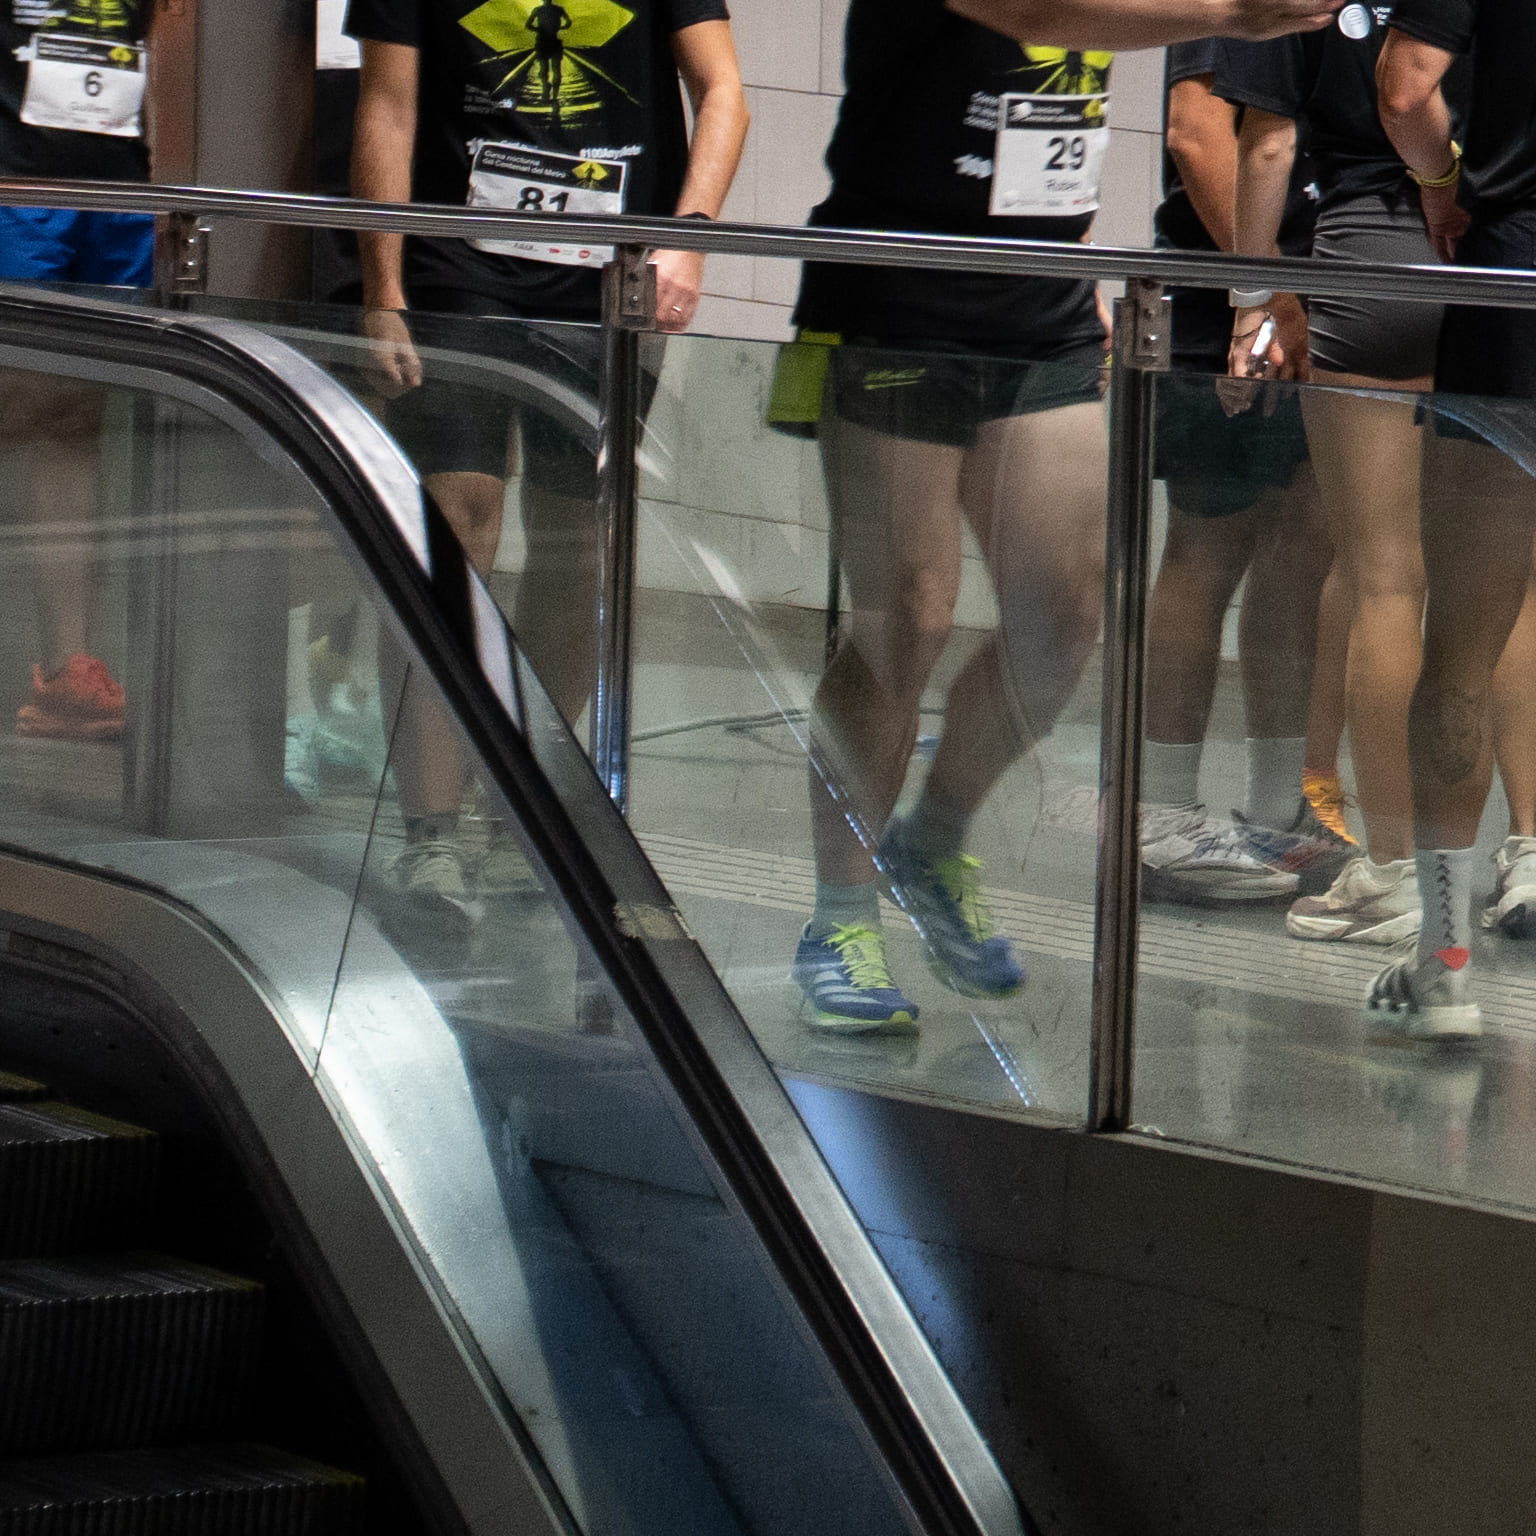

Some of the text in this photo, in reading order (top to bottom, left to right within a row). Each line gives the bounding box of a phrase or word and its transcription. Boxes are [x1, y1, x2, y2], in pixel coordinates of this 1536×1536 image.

[84, 71, 103, 97] 6
[1045, 137, 1084, 170] 29
[517, 187, 569, 212] 81
